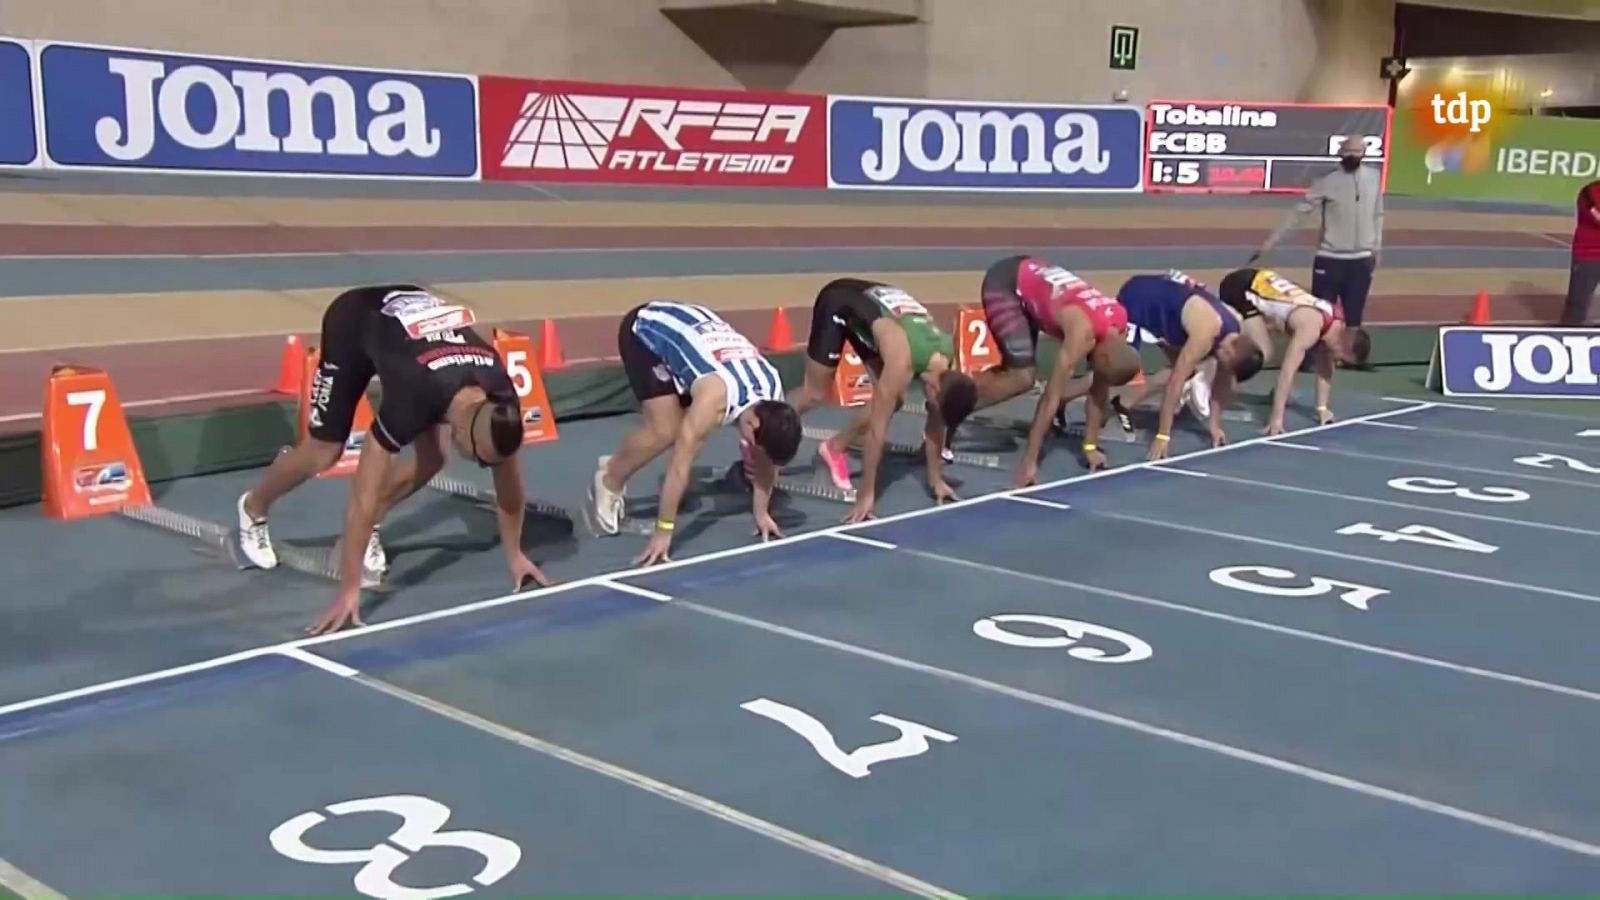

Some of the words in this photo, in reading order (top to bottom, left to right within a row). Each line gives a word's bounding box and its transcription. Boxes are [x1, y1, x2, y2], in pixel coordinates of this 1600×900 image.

[1150, 104, 1277, 127] Tobalina
[1149, 132, 1227, 153] FCBB
[609, 151, 794, 174] ATLETISMO
[1497, 147, 1600, 178] IBERD
[968, 319, 990, 356] 2
[507, 351, 533, 397] 5
[66, 389, 107, 451] 7
[1387, 476, 1531, 503] 3
[1334, 522, 1500, 554] 4
[1208, 565, 1391, 611] 5
[973, 614, 1153, 663] 6
[740, 698, 959, 778] 7
[269, 794, 522, 900] 8
